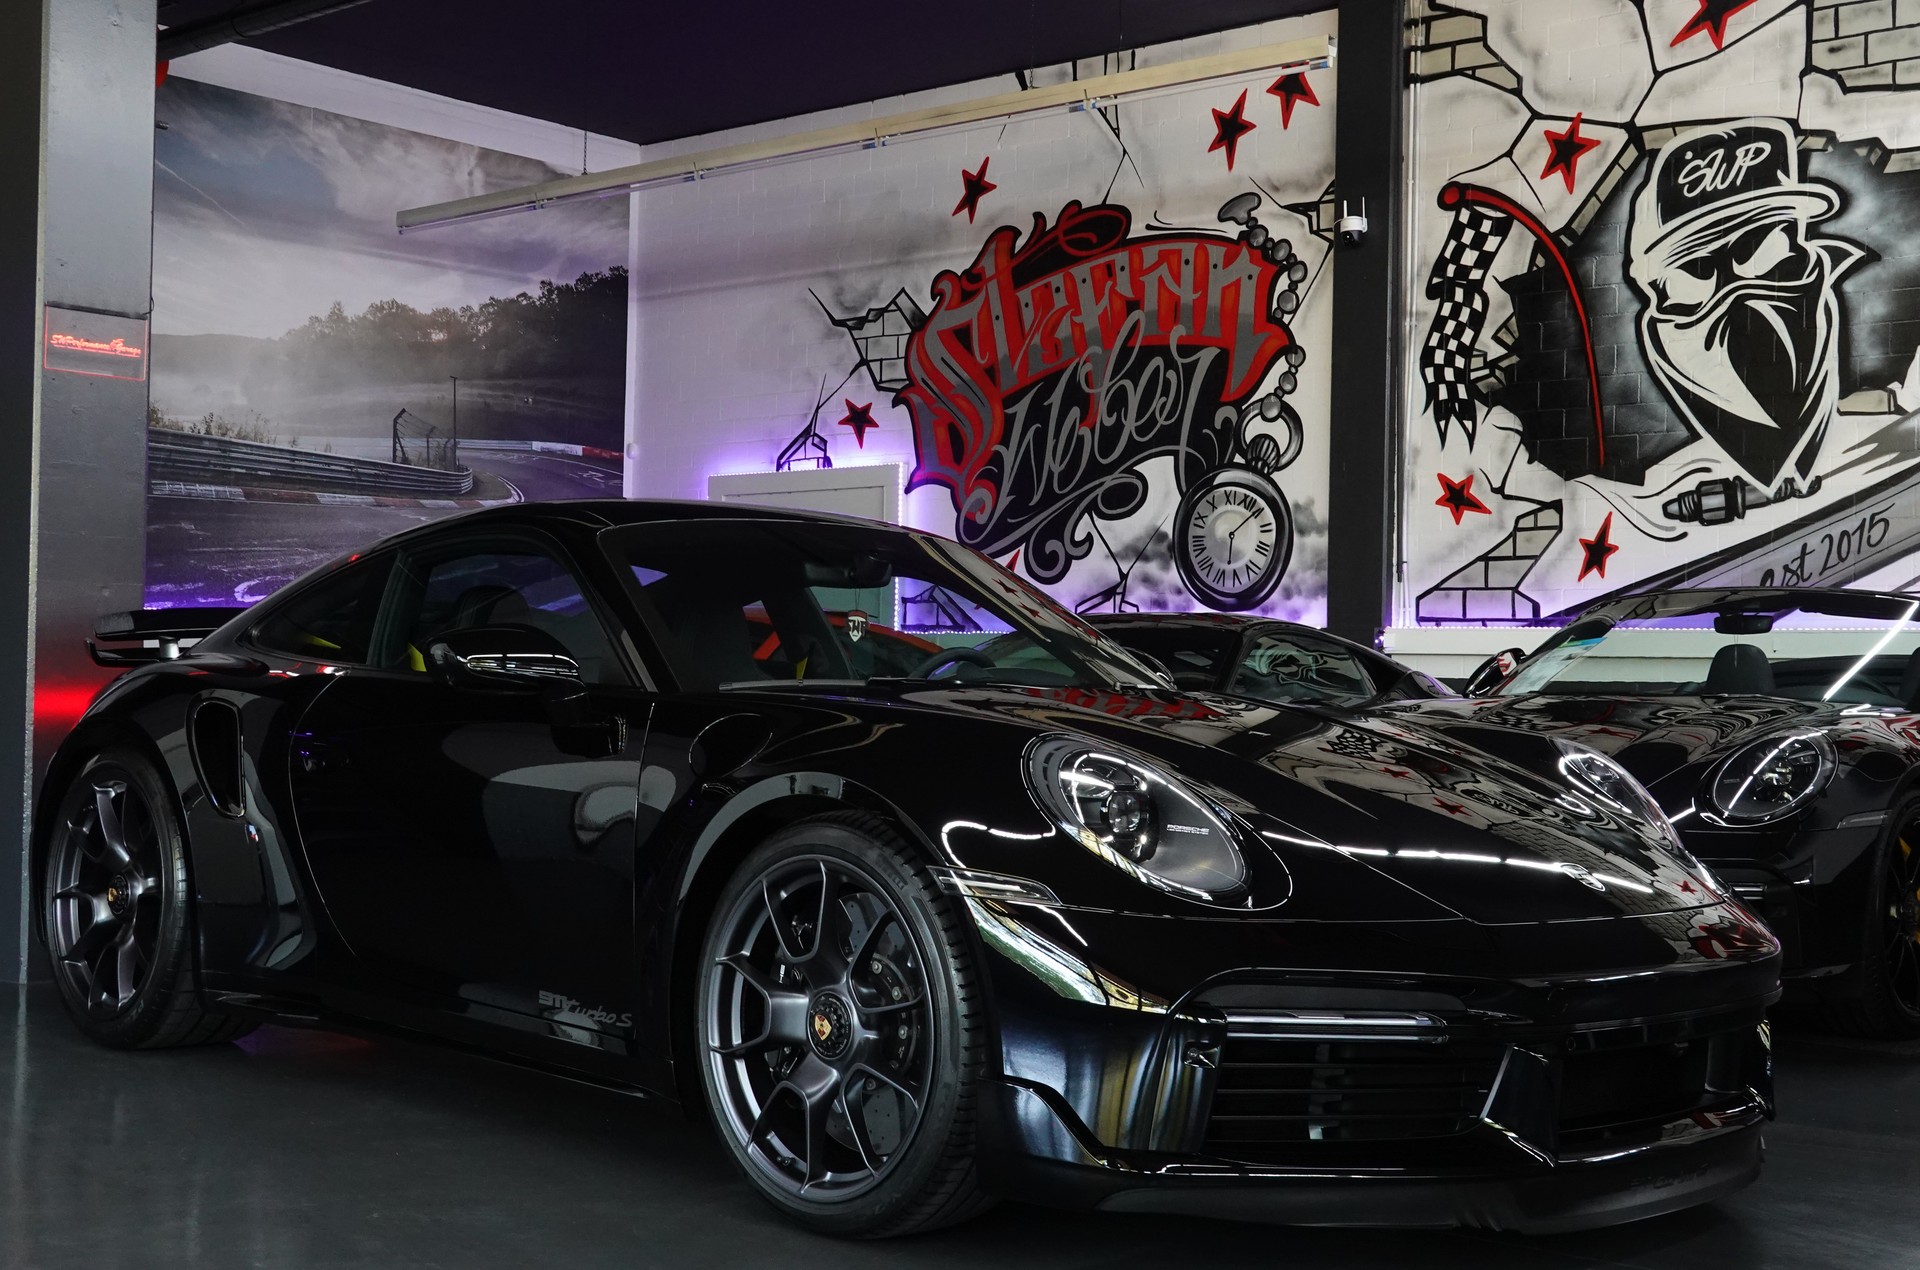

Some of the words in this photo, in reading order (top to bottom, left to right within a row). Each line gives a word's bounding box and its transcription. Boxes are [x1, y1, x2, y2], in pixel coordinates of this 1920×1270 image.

[1678, 141, 1772, 198] SWP
[957, 310, 1222, 544] Weber
[1819, 503, 1896, 576] 2015
[615, 1012, 633, 1028] S
